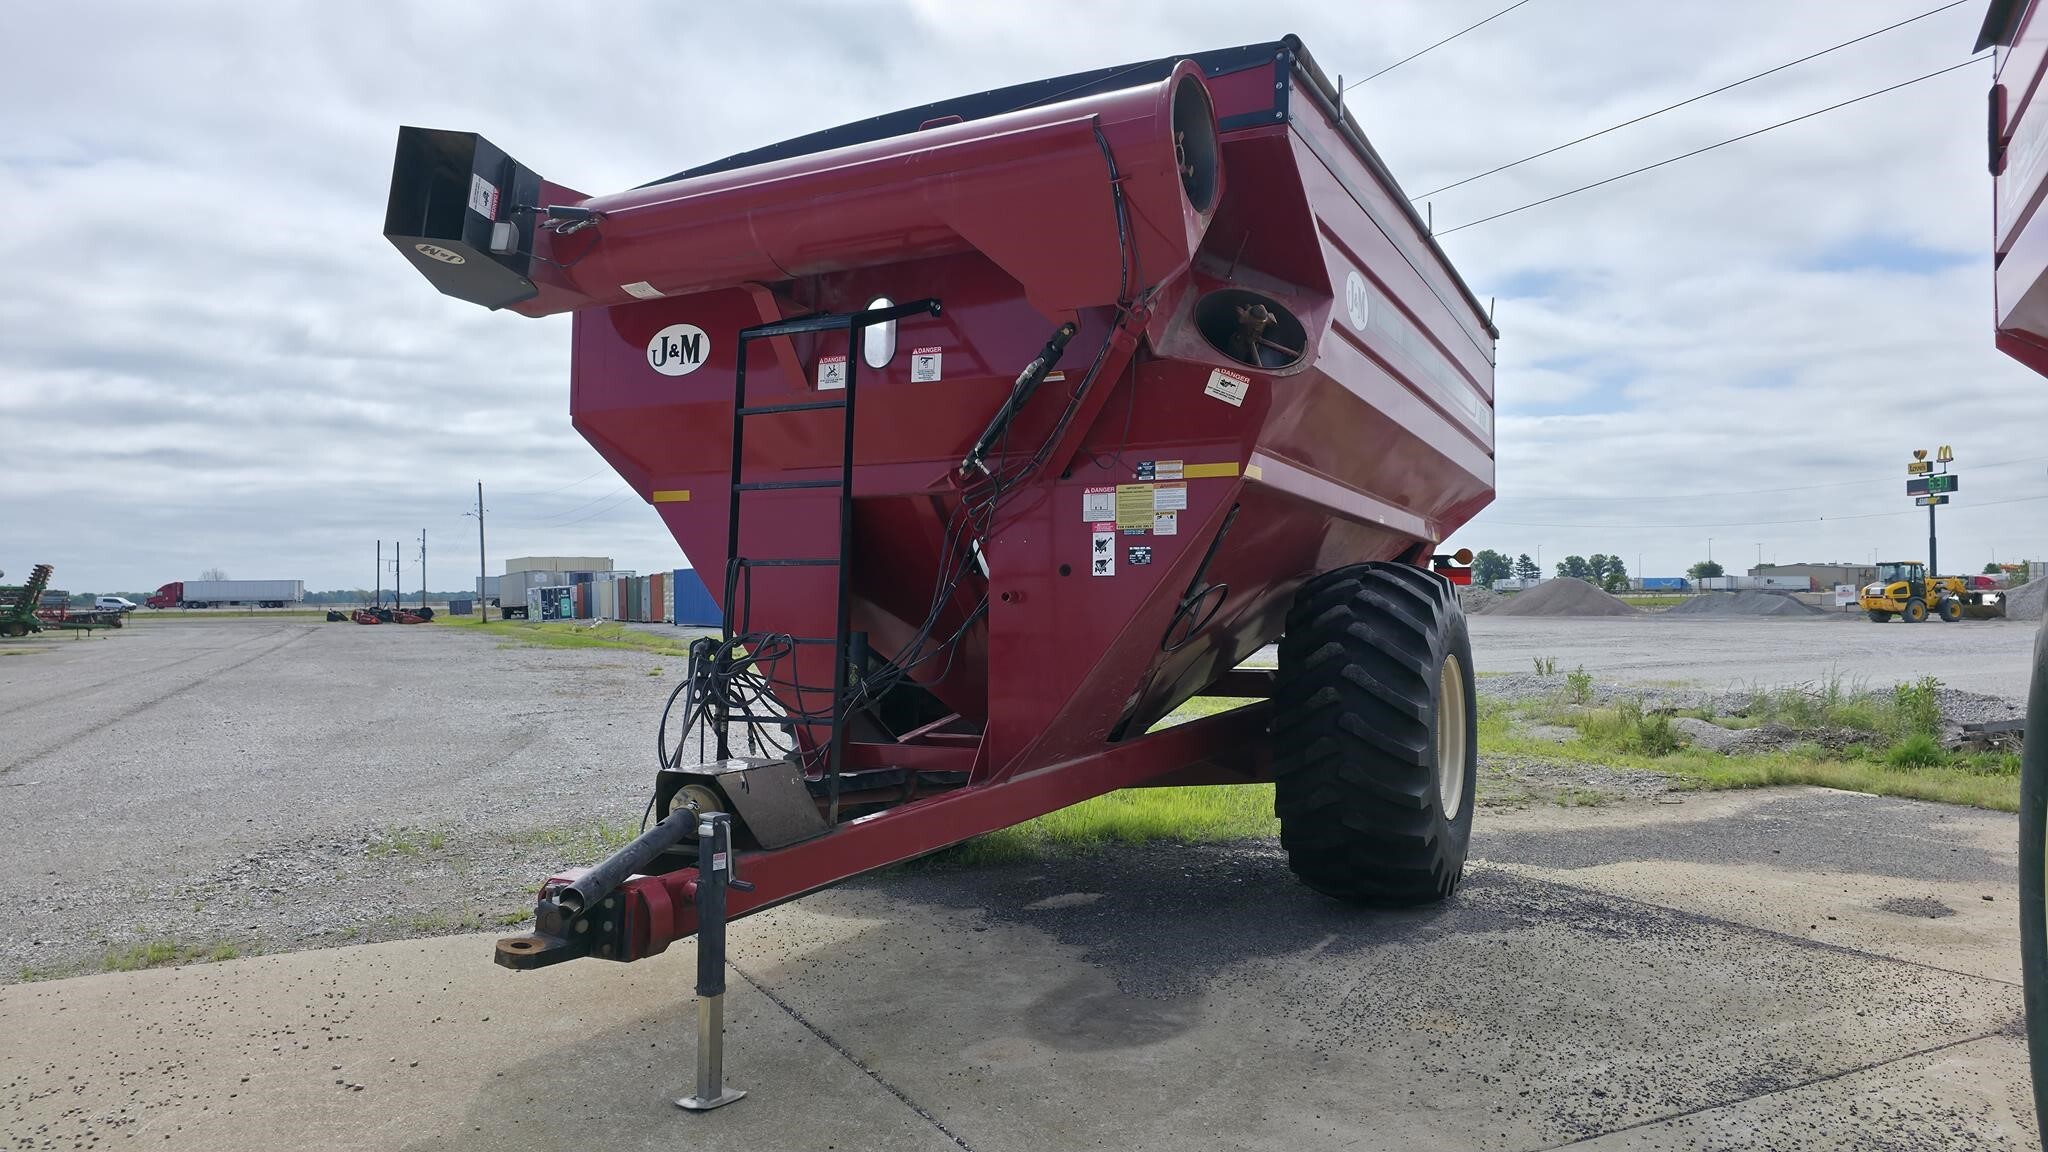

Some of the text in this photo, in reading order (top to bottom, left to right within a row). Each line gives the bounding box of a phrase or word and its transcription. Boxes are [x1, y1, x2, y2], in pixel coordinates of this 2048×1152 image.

[421, 246, 464, 262] J&M
[652, 333, 702, 367] J&M
[1220, 368, 1250, 384] DANGER
